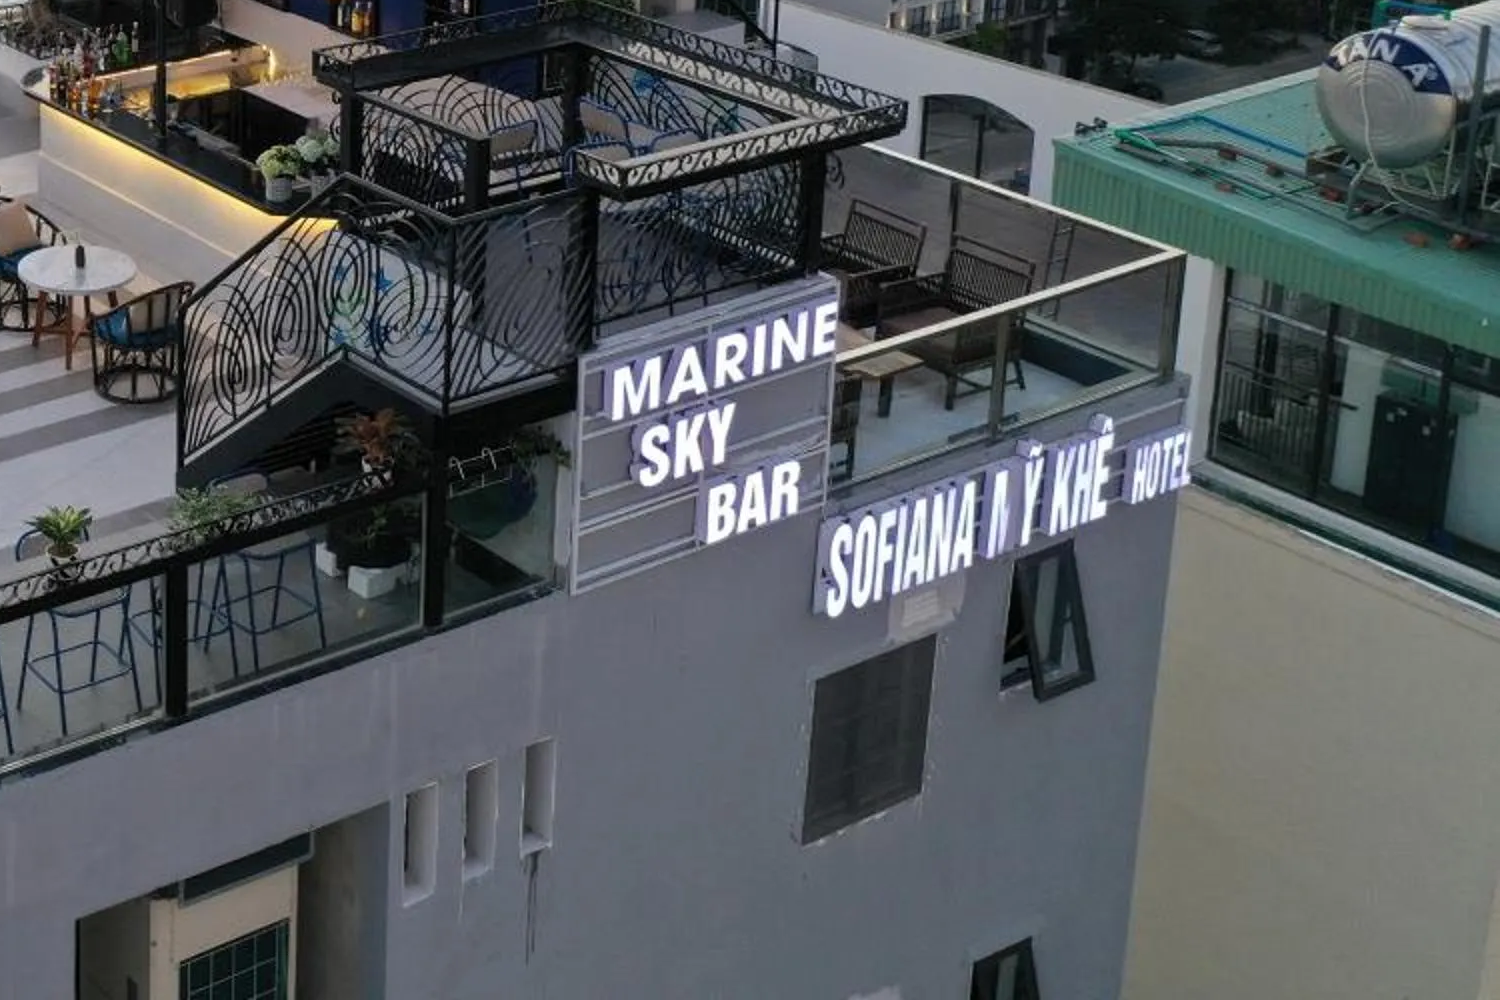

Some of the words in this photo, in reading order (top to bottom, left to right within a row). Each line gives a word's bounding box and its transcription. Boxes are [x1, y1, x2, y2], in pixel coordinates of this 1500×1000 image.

[611, 301, 839, 421] MARINE
[638, 402, 736, 488] SKY
[706, 459, 801, 544] BAR
[826, 480, 977, 618] SOFIANA
[1048, 416, 1115, 536] KHÊ
[1130, 428, 1193, 505] HOTEL
